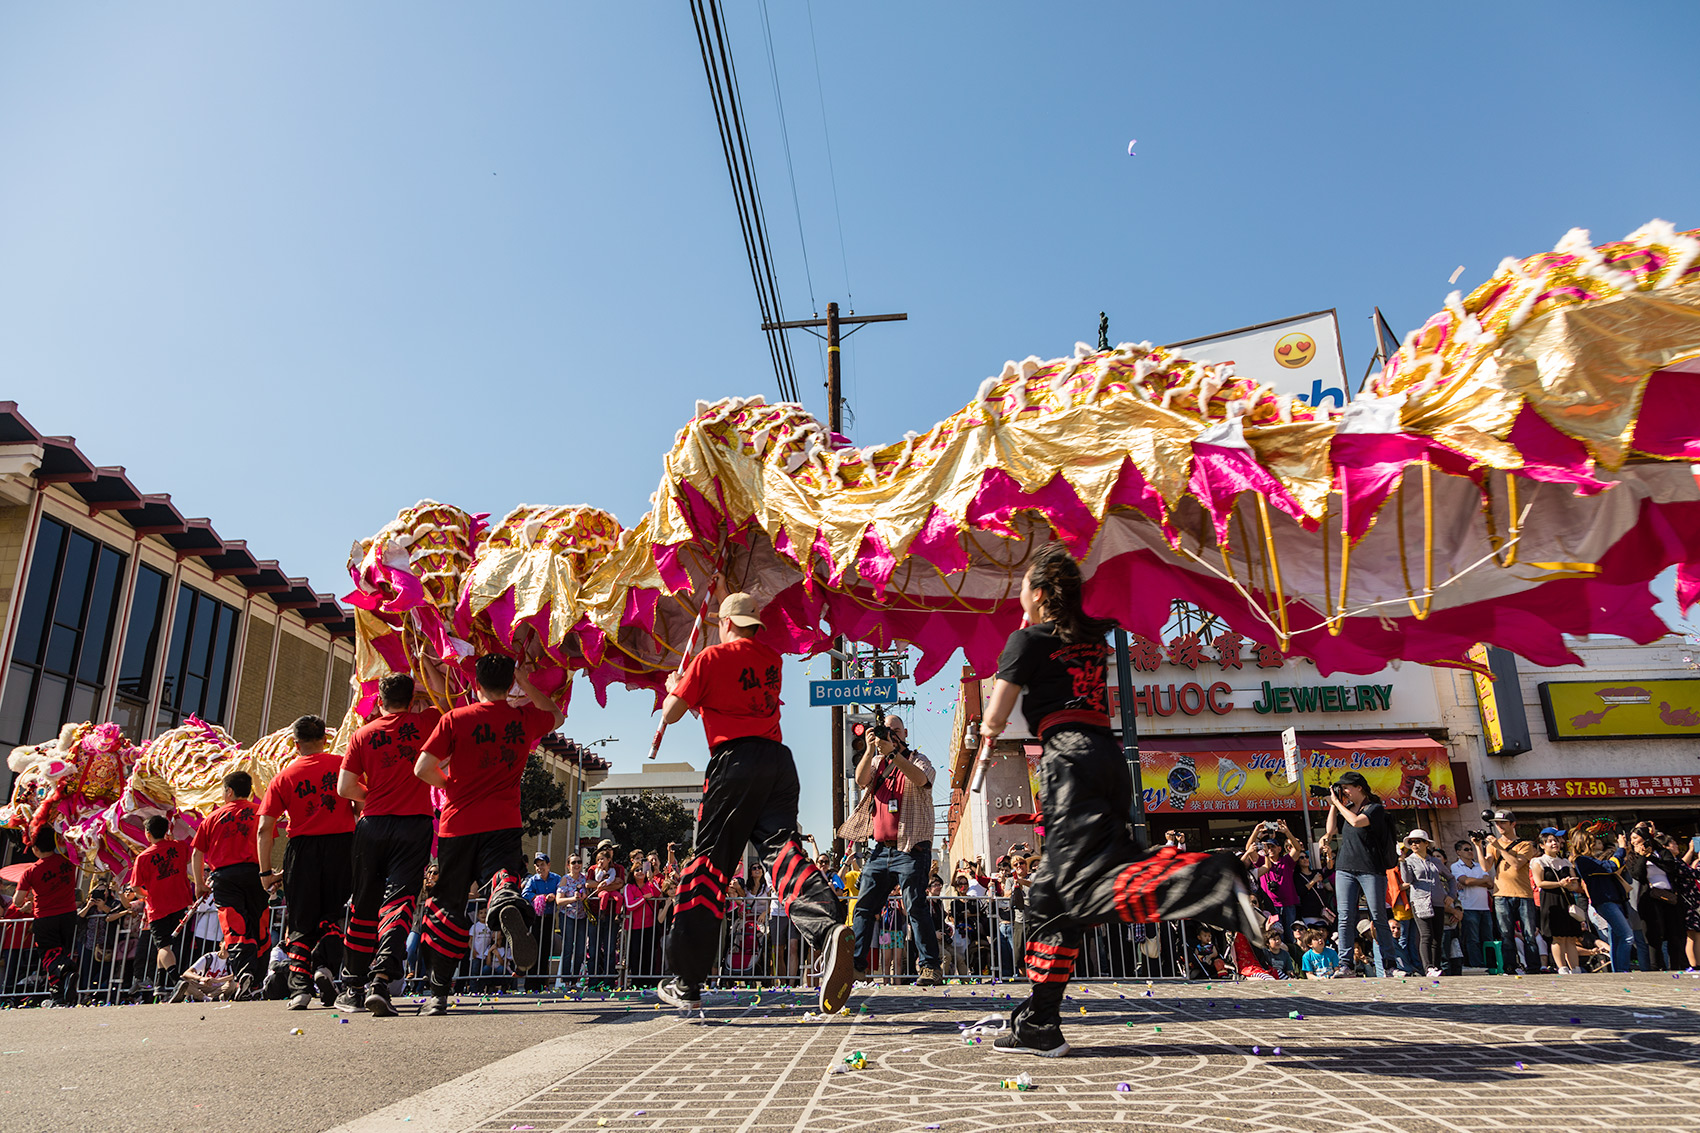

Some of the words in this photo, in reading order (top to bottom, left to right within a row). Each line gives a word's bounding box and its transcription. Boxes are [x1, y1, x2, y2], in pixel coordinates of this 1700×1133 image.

[816, 685, 891, 699] Broadway
[1253, 681, 1393, 714] JEWELRY
[1247, 752, 1308, 775] Hap
[1310, 752, 1348, 769] New
[1349, 752, 1391, 770] Year
[1501, 781, 1560, 797] 特價午餐
[1565, 780, 1607, 797] $7.50
[1619, 777, 1693, 789] 星期一至星期五
[995, 795, 1022, 808] 801
[1190, 800, 1240, 811] 恭賀新禧
[1246, 799, 1297, 810] 新年快樂
[1576, 818, 1618, 834] Oen
